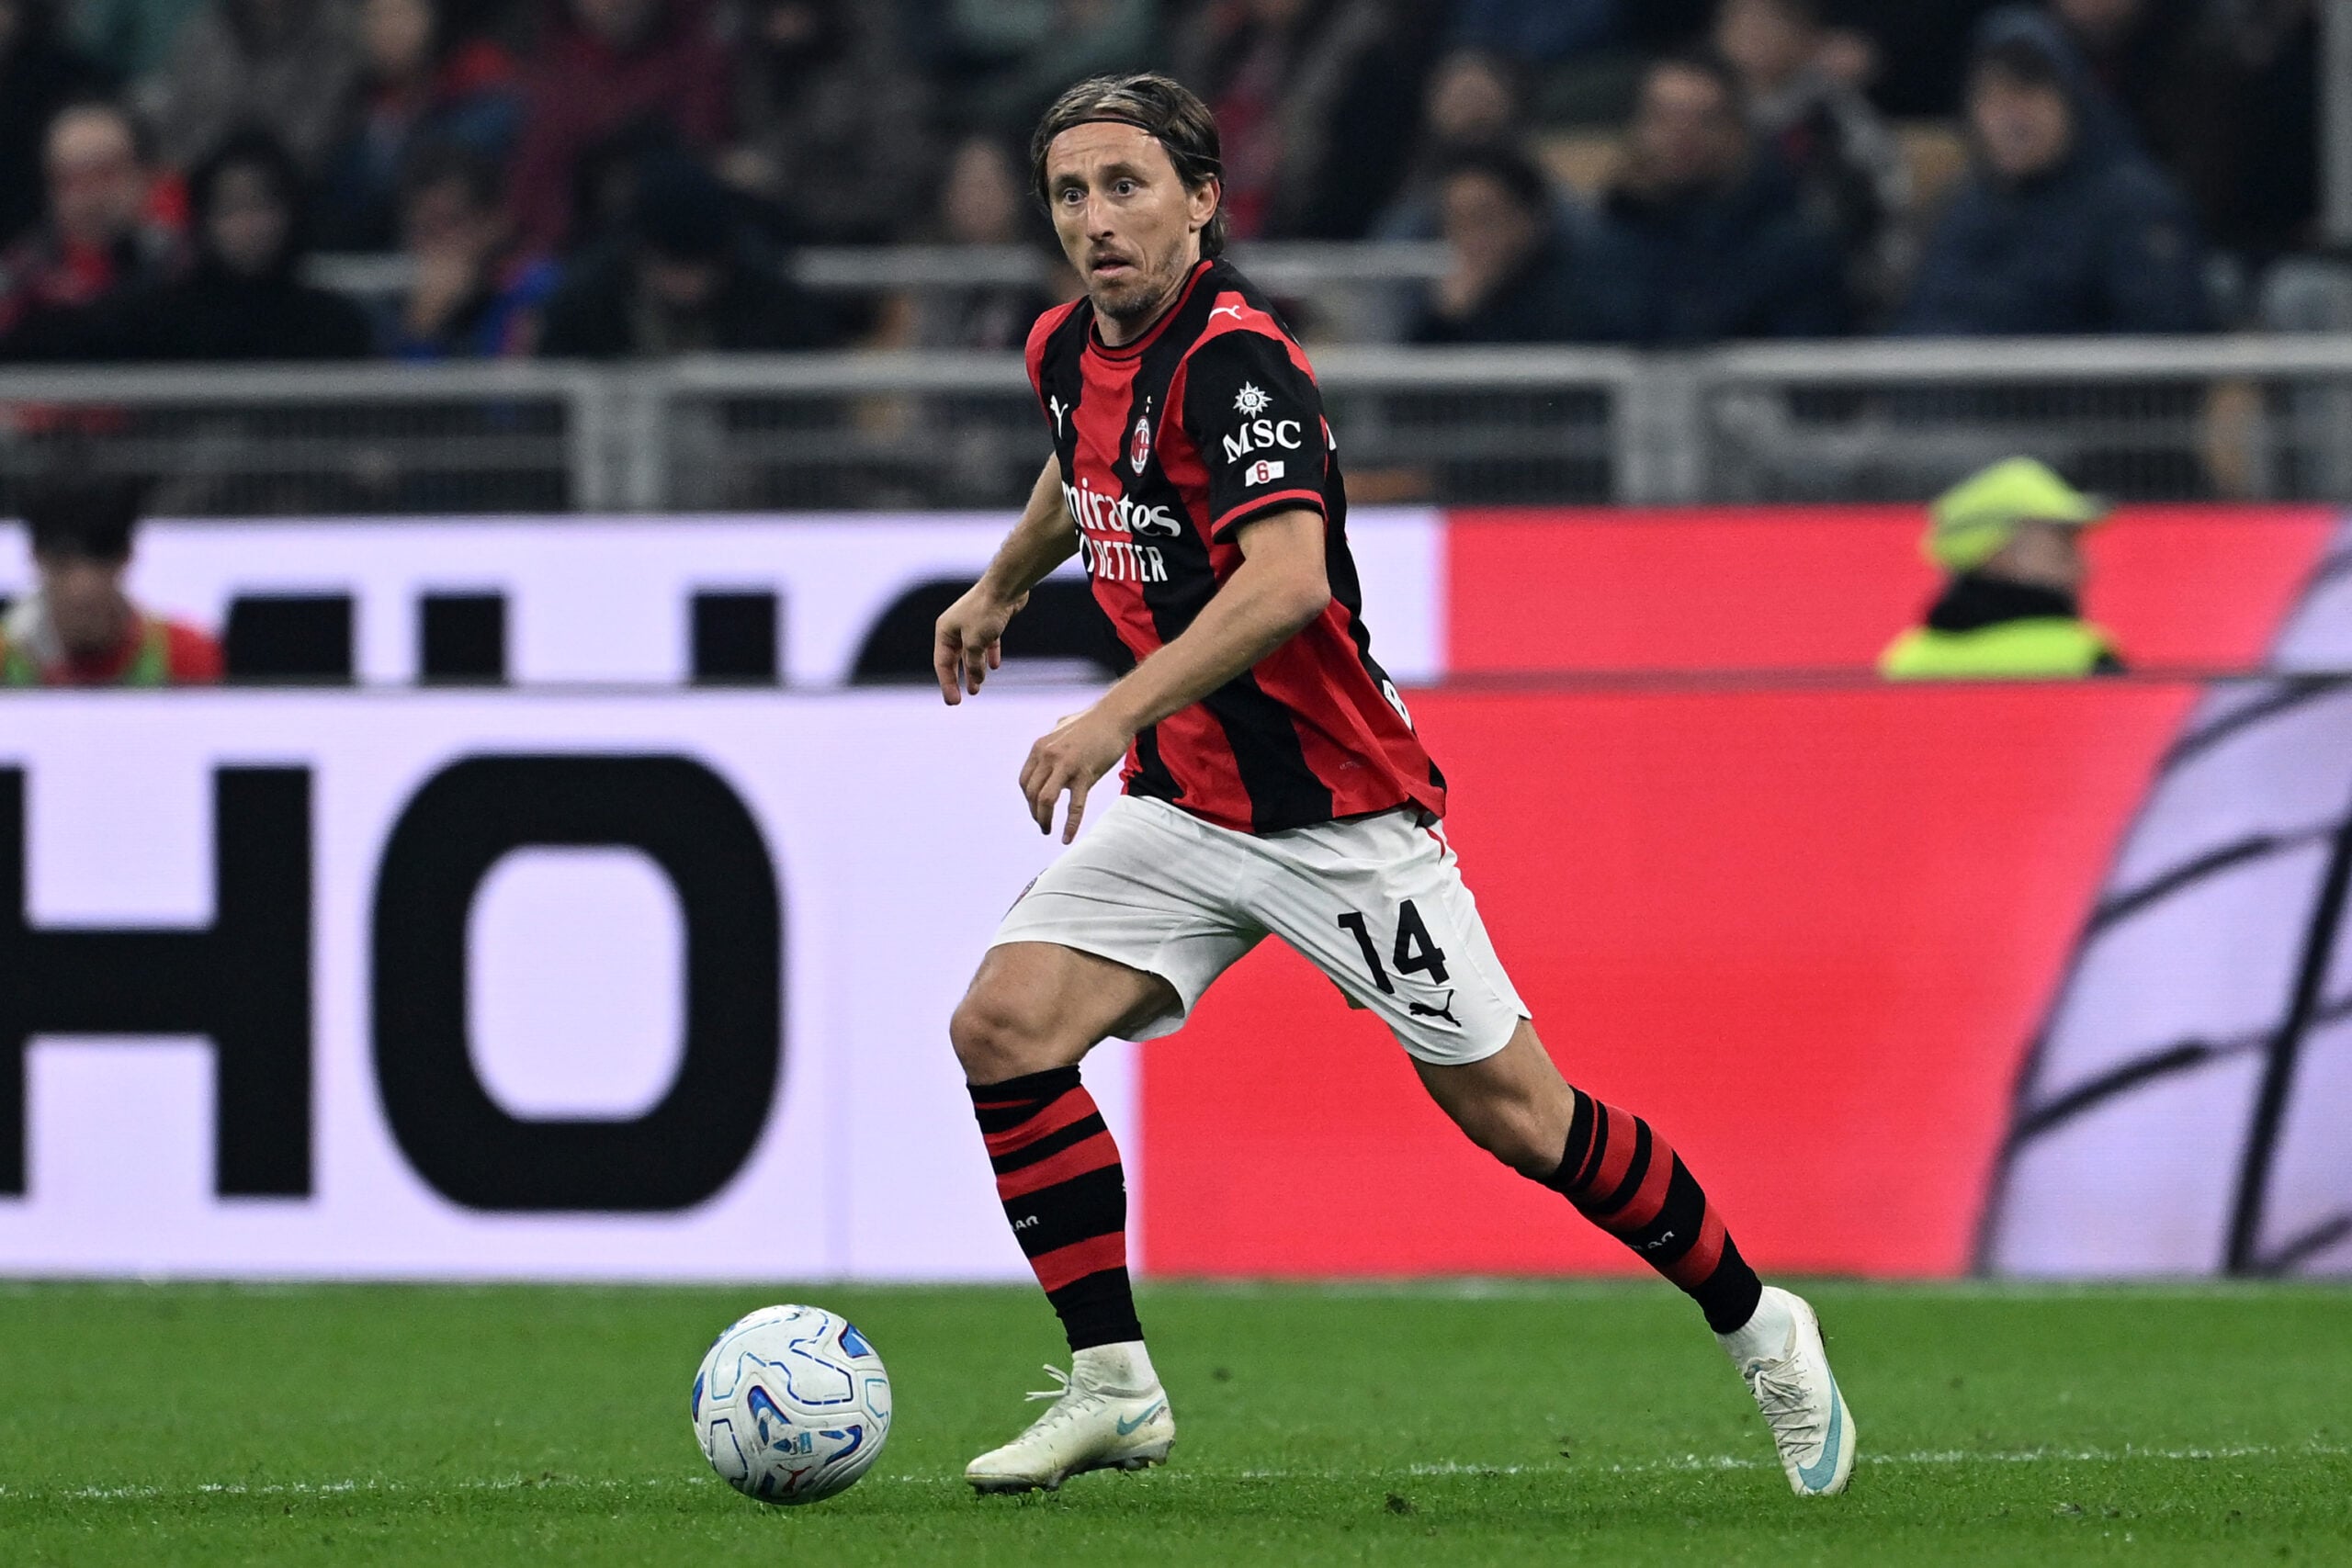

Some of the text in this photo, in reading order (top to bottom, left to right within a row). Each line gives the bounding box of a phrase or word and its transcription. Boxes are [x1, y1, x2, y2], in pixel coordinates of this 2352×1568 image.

[1223, 419, 1302, 464] MSC
[1256, 461, 1269, 482] 6
[1062, 478, 1182, 537] mirates
[1338, 898, 1450, 995] 14
